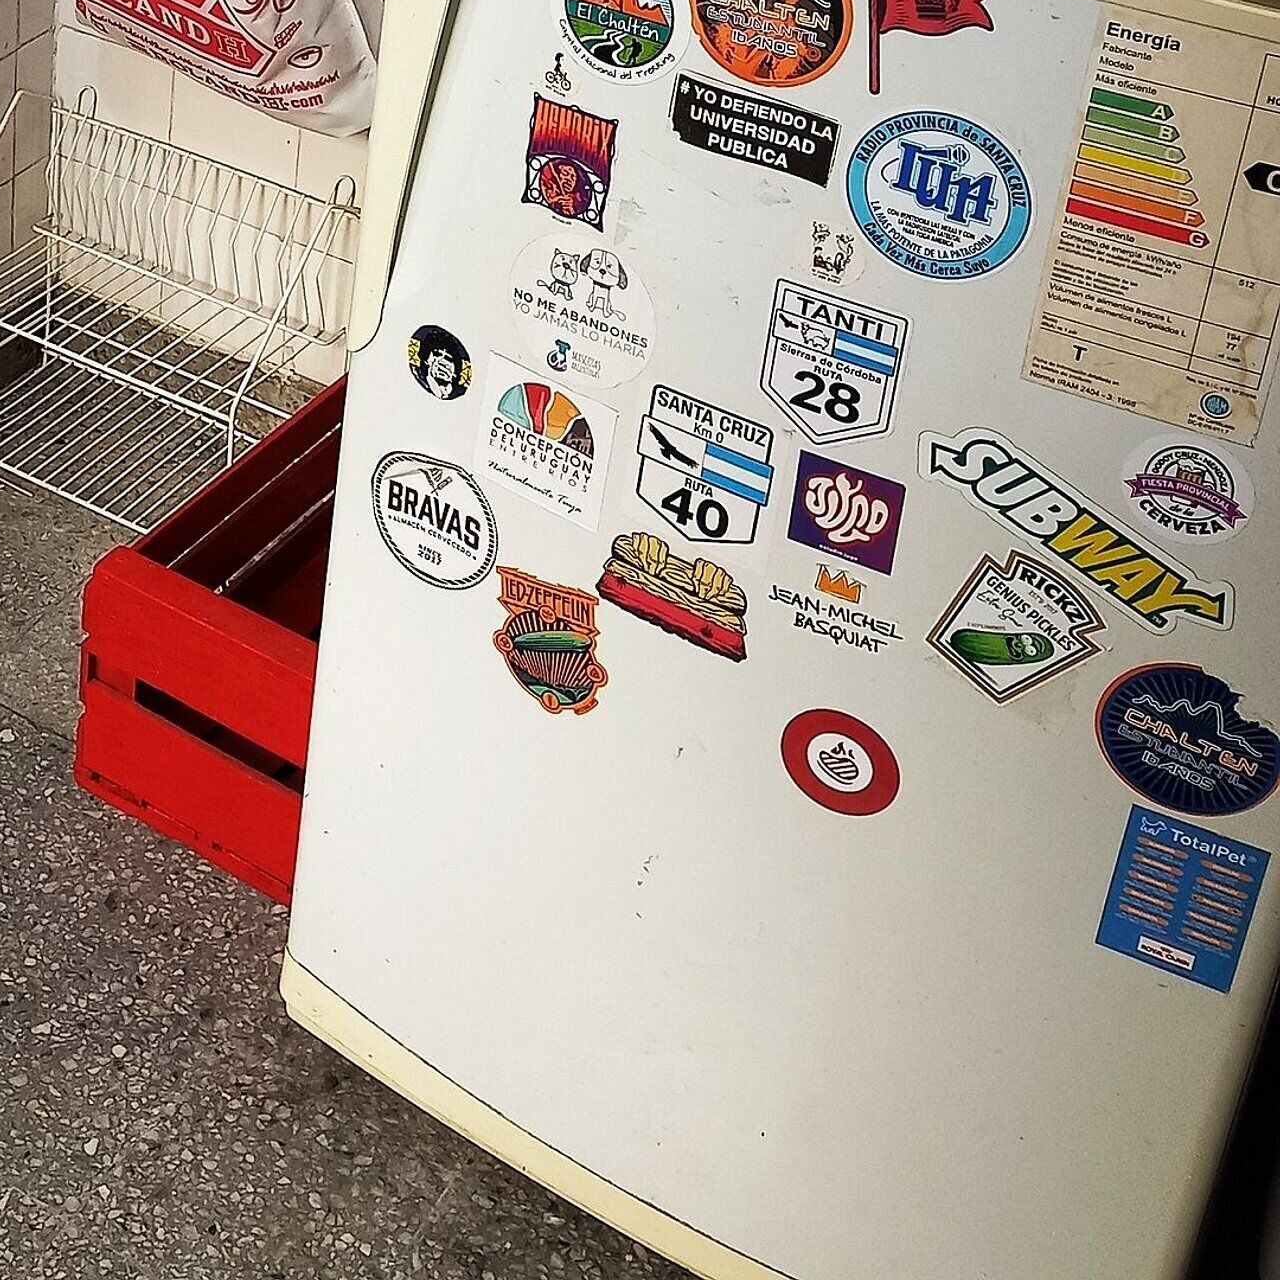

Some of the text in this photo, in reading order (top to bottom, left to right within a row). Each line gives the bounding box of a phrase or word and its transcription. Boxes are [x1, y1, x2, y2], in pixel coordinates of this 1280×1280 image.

[577, 2, 659, 42] El Chaltén
[1106, 21, 1181, 51] Energía
[1099, 56, 1135, 71] Modelo
[1102, 42, 1152, 61] Fabricante
[1117, 80, 1157, 96] eficiente
[690, 105, 817, 155] UNIVERSIDAD
[694, 85, 717, 105] YO
[720, 94, 807, 131] DEFIENDO
[810, 119, 834, 142] LA
[1151, 104, 1167, 120] A
[708, 132, 788, 169] PUBLICA
[1159, 125, 1174, 140] B
[856, 115, 1027, 208] RADIO PROVINCIA de SANTA CRUZ
[863, 222, 886, 247] Cada
[1063, 216, 1136, 243] Menos eficiente
[1183, 210, 1198, 224] F
[937, 250, 950, 260] LA
[1060, 231, 1099, 247] Consumo
[1188, 229, 1207, 248] G
[1047, 292, 1081, 308] Volumen
[1049, 282, 1084, 298] Volumen
[513, 298, 531, 315] YO
[581, 326, 600, 342] LO
[514, 287, 649, 349] NO ME ABANDONES
[796, 296, 884, 341] TANTI
[779, 342, 882, 385] Sierras de Córdoba
[1072, 344, 1088, 361] T
[813, 365, 843, 382] RUTA
[789, 370, 862, 424] 28
[657, 391, 768, 448] SANTA CRUZ
[693, 423, 724, 444] Km 0
[492, 417, 593, 474] CONCEPCIÓN
[684, 477, 714, 498] RUTA
[1141, 479, 1230, 511] FIESTA PROVINCIAL
[387, 479, 481, 551] BRAVAS
[661, 487, 729, 538] 40
[931, 438, 1225, 624] SUBWAY
[1139, 499, 1227, 535] CERVEZA
[768, 584, 904, 641] JEAN-MICHEL
[986, 575, 1077, 652] GENIUS PICKLES
[1018, 566, 1086, 624] RICKZ
[794, 611, 889, 653] BASQUIAT
[1124, 707, 1259, 777] CHALTEN
[1171, 828, 1248, 867] TotalPet
